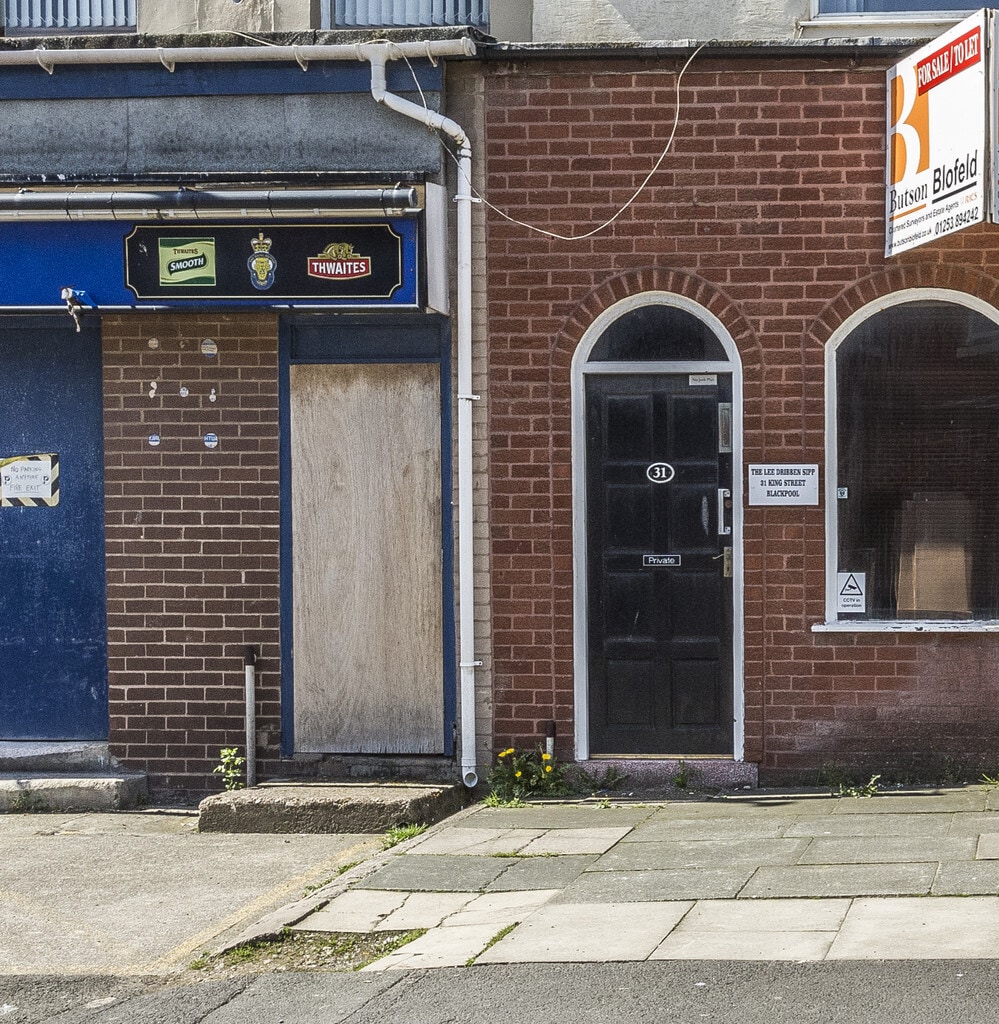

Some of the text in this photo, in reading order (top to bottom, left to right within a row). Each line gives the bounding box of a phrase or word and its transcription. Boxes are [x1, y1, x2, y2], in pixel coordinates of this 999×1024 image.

[917, 64, 931, 88] FOR
[931, 51, 949, 79] SALE
[954, 41, 965, 65] TO
[964, 33, 979, 61] LET
[890, 150, 978, 214] Butson Blofeld
[906, 216, 925, 231] Surveyors
[925, 212, 933, 221] and
[946, 201, 959, 213] Agents
[934, 216, 954, 235] 01253
[955, 206, 979, 228] 894242
[170, 257, 205, 272] SMOOTH
[312, 261, 367, 275] THWAITES
[653, 466, 668, 479] 31
[751, 468, 763, 476] THE
[764, 468, 775, 476] LEE
[802, 468, 816, 476] SIPP
[760, 479, 806, 487] 31 KING STREET
[766, 489, 800, 497] BLACKPOOL
[648, 556, 676, 564] Private
